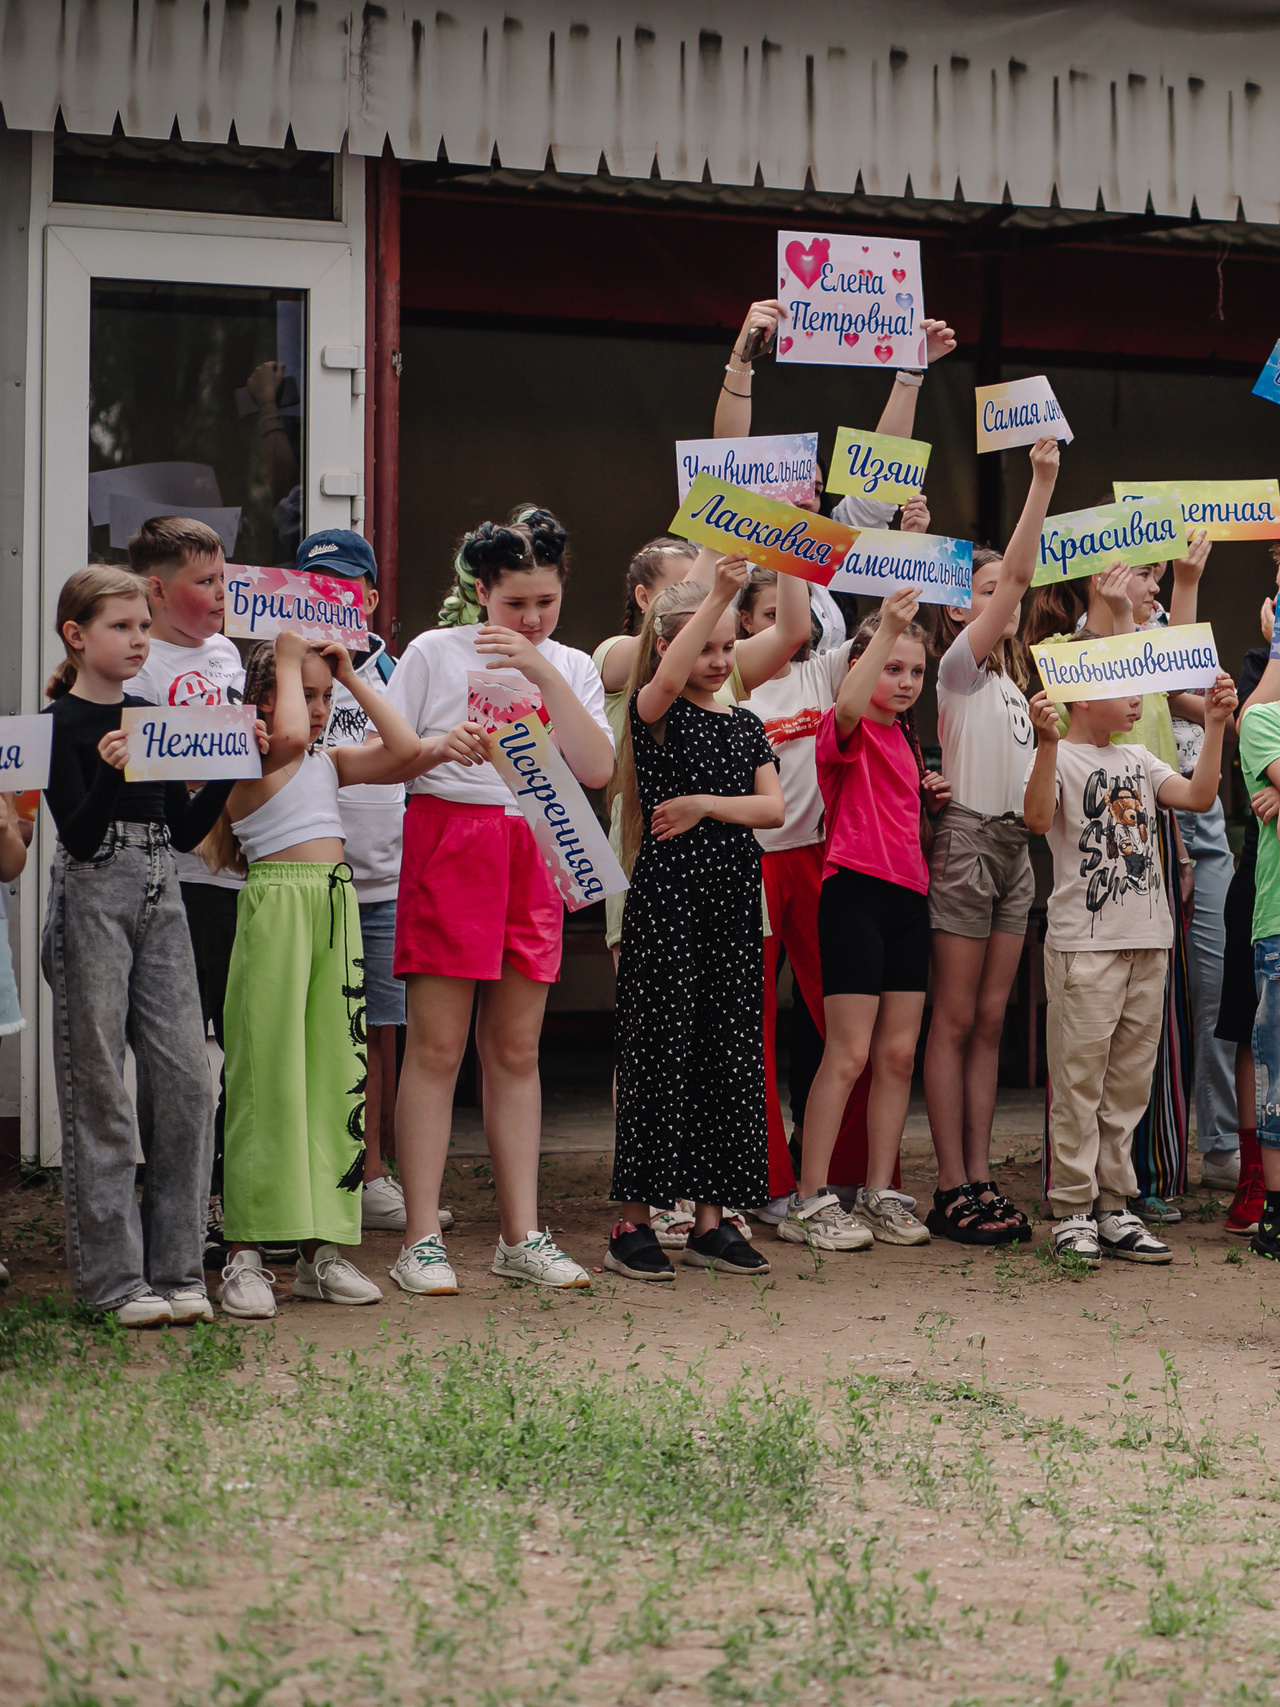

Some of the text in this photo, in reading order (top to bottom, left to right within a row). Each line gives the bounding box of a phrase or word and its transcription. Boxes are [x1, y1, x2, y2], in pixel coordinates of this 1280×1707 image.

[820, 263, 887, 295] Елена
[790, 301, 914, 346] Петровна!
[983, 400, 1065, 433] Самая лю
[691, 494, 833, 565] Ласковая
[1040, 510, 1178, 575] Красивая
[228, 580, 363, 632] Брильянт
[1038, 642, 1217, 686] Необыкновенная
[142, 721, 250, 758] Нежная
[499, 722, 604, 900] Искренняя
